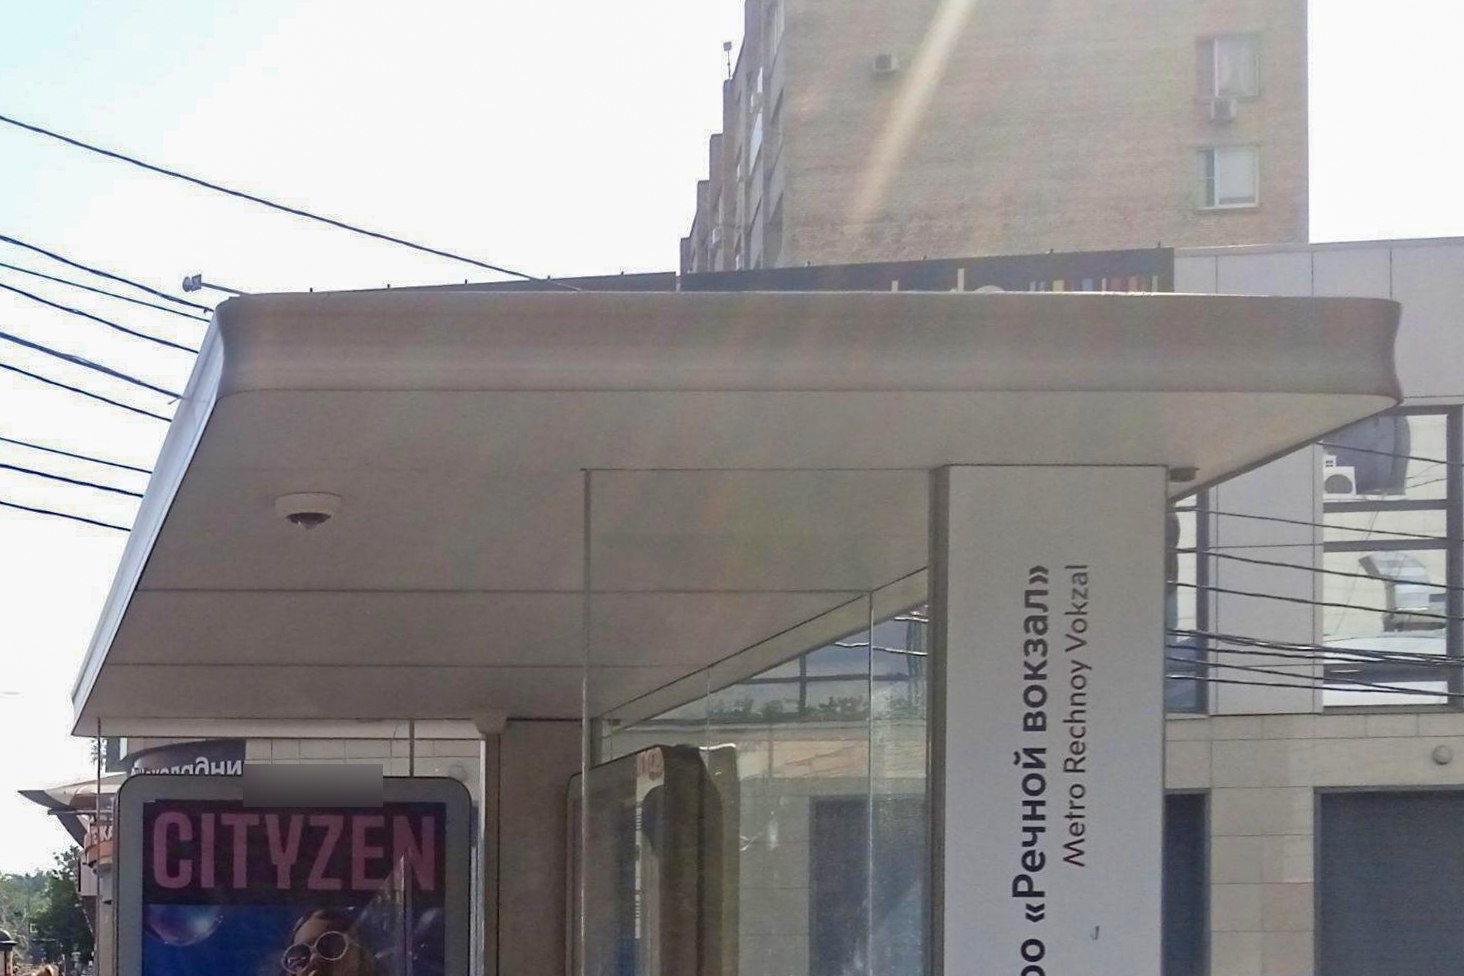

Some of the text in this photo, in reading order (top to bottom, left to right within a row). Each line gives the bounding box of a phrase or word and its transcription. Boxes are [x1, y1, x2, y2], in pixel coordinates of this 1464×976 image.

[1022, 564, 1050, 733] вокзал»
[1062, 563, 1093, 868] Metro Rechnoy Vokzal
[152, 810, 437, 892] CITYZEN
[1011, 745, 1048, 925] «Речной
